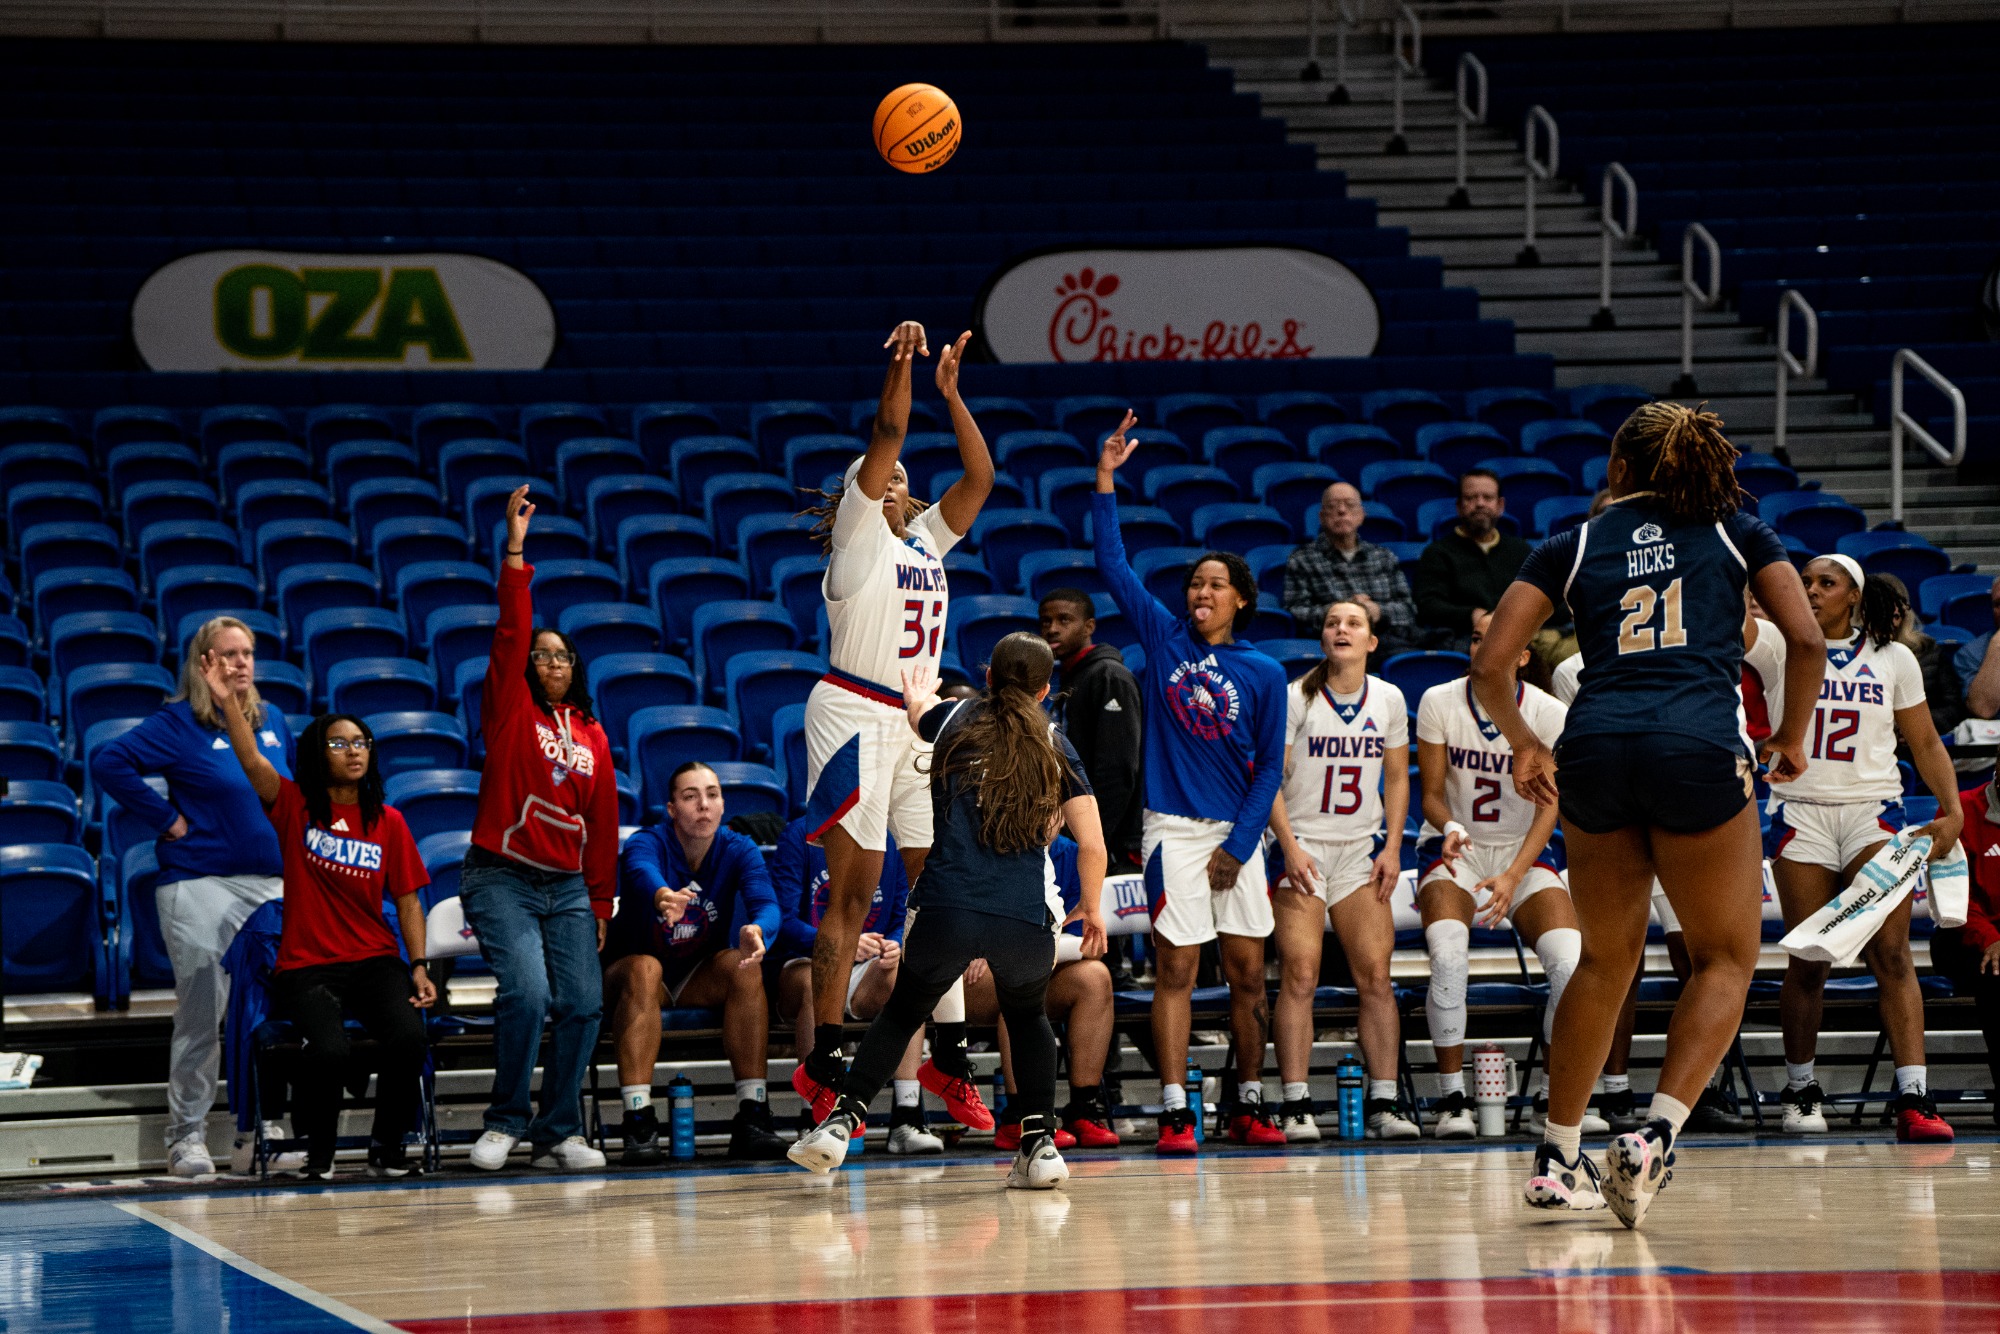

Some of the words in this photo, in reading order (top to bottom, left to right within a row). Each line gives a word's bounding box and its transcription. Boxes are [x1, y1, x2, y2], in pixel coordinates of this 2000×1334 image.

[904, 118, 956, 157] Wilson
[212, 262, 475, 364] OZA
[1626, 543, 1676, 578] HICKS
[1617, 577, 1688, 656] 21
[1169, 660, 1191, 684] WEST
[1222, 680, 1240, 722] WOLVES
[1818, 678, 1884, 706] OLVES
[1307, 735, 1386, 759] WOLVES
[1810, 707, 1860, 763] 12
[1449, 746, 1513, 775] WOLV
[1319, 764, 1363, 816] 13
[1471, 776, 1501, 823] 2
[1112, 880, 1148, 909] UW
